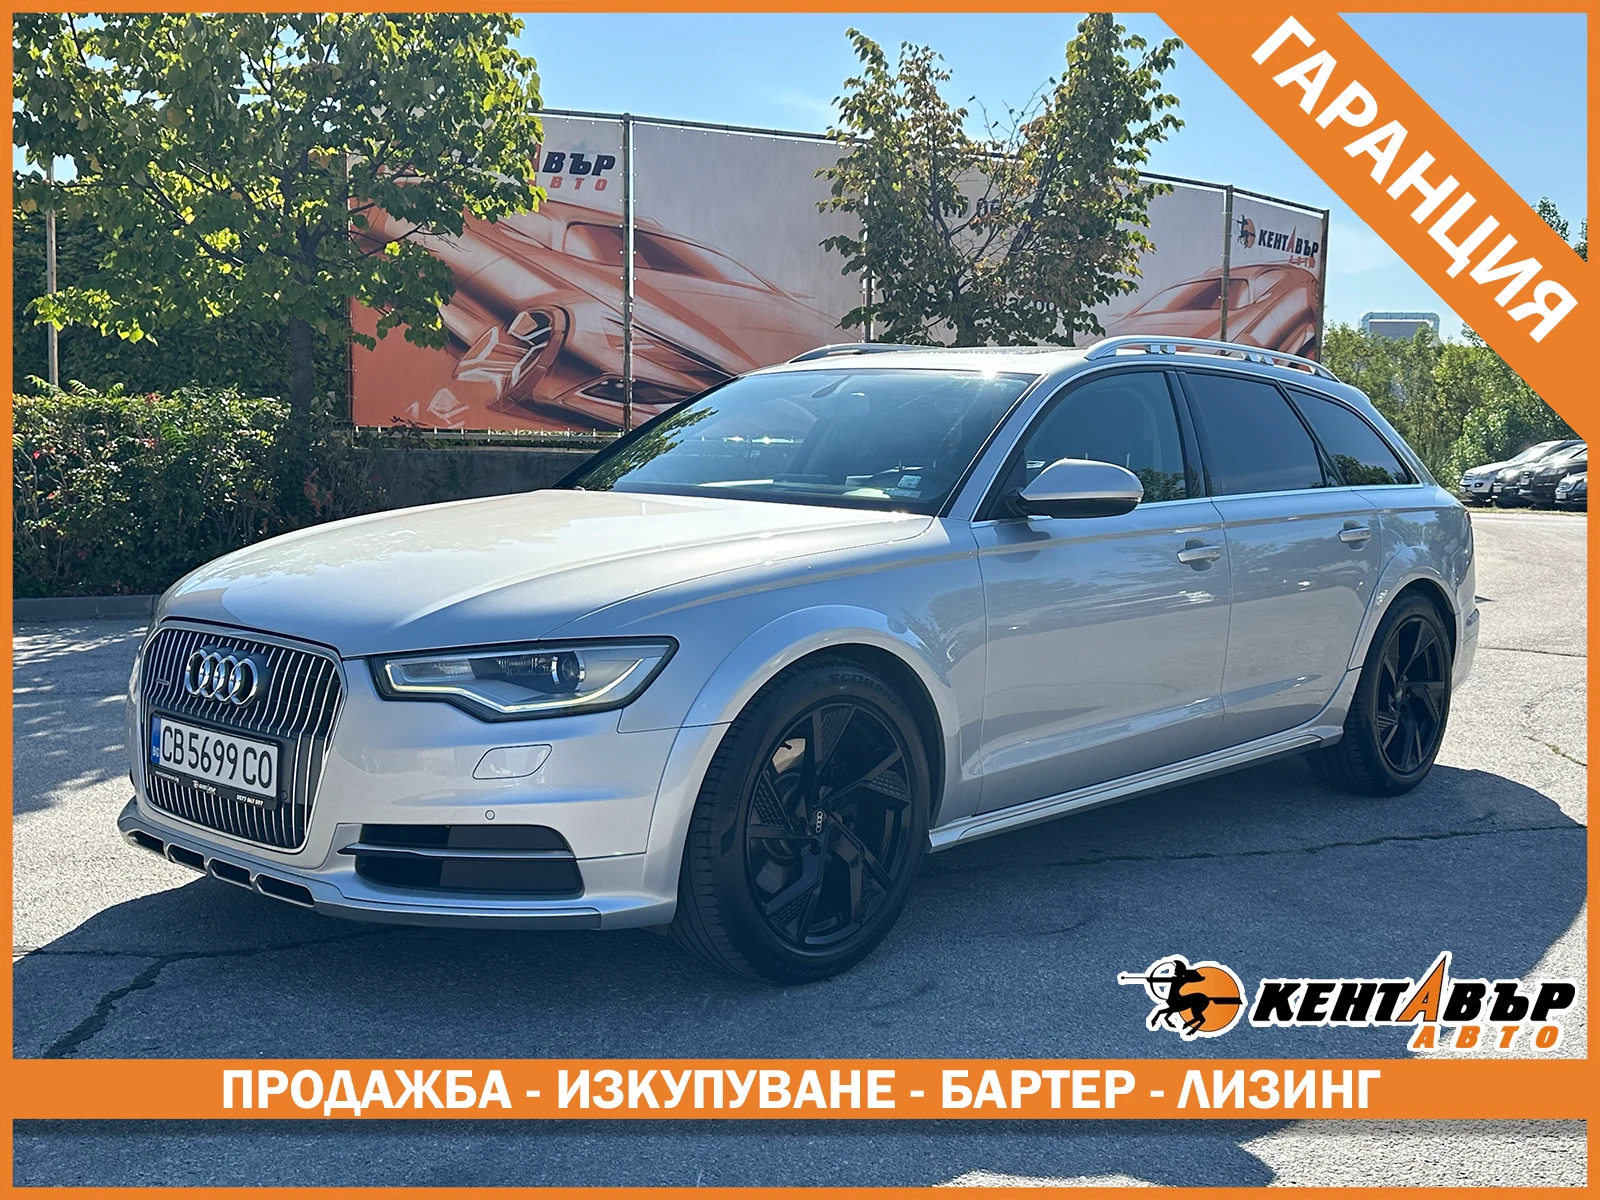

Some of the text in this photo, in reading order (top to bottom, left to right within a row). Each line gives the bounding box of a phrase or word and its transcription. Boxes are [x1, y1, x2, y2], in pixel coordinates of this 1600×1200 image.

[534, 147, 616, 176] ВЪР
[530, 176, 608, 192] ВТО
[1258, 226, 1319, 257] КЕНТАВЪР
